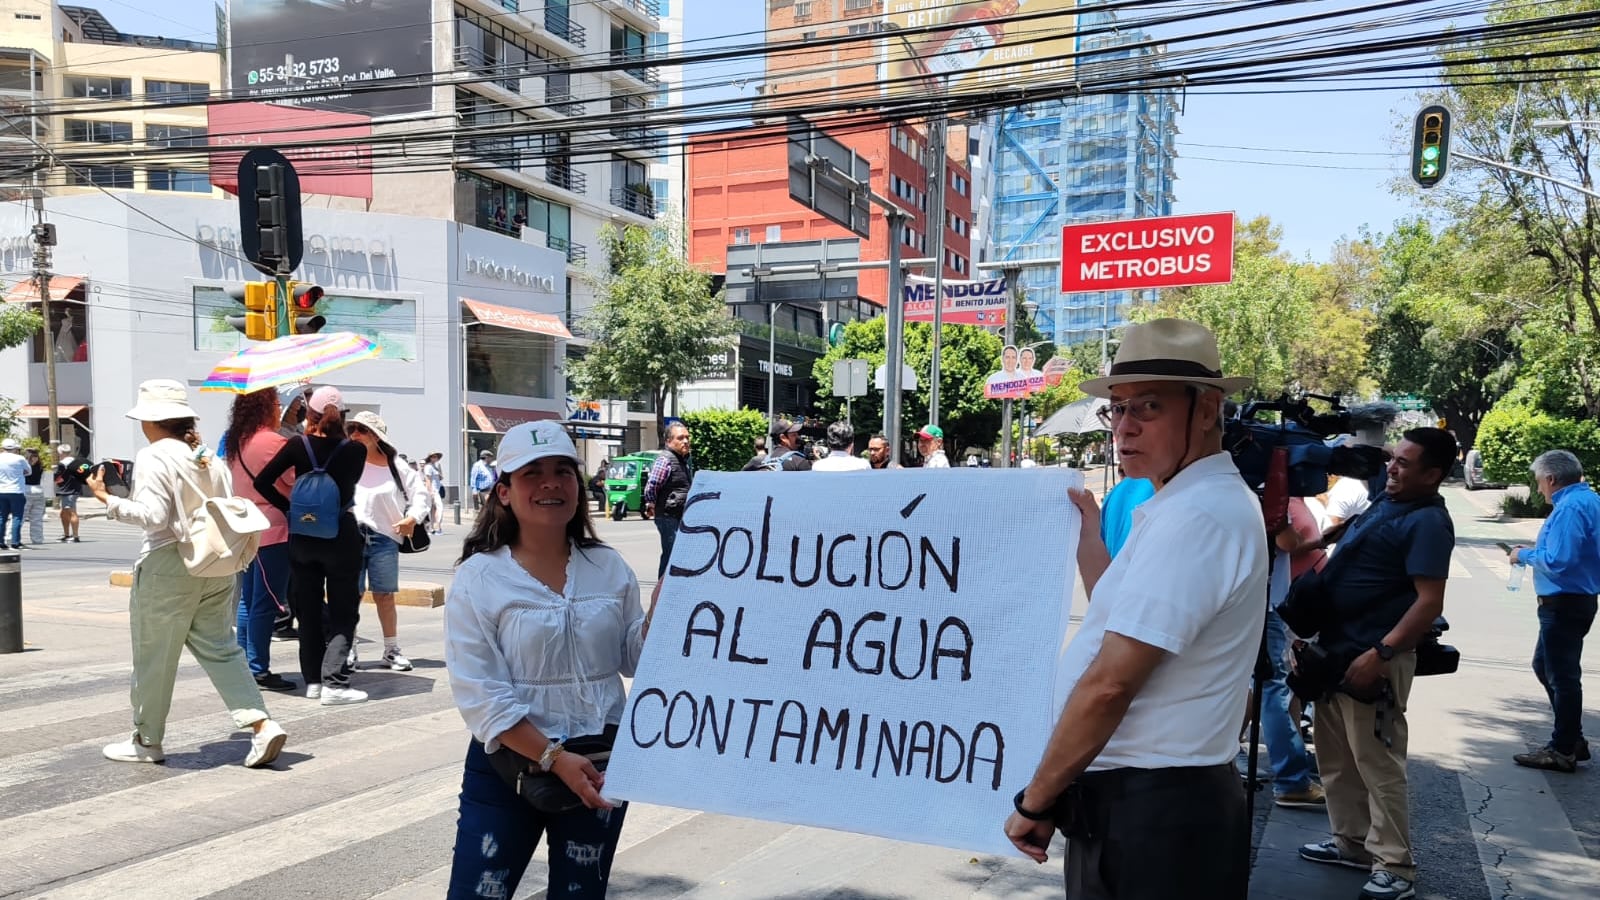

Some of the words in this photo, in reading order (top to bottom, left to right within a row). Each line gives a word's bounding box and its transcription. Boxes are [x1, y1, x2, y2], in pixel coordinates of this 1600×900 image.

[993, 45, 1035, 61] BECAUSE
[260, 67, 274, 83] 55
[309, 57, 340, 75] 5733
[1081, 225, 1215, 254] EXCLUSIVO
[1080, 253, 1212, 281] METROBUS
[955, 299, 984, 308] BENITO
[990, 379, 1028, 394] MENDOZA
[669, 491, 961, 593] SOLUCIÓN
[682, 601, 769, 665] AL
[802, 608, 974, 682] AGUA
[630, 687, 1006, 791] CONTAMINADA
